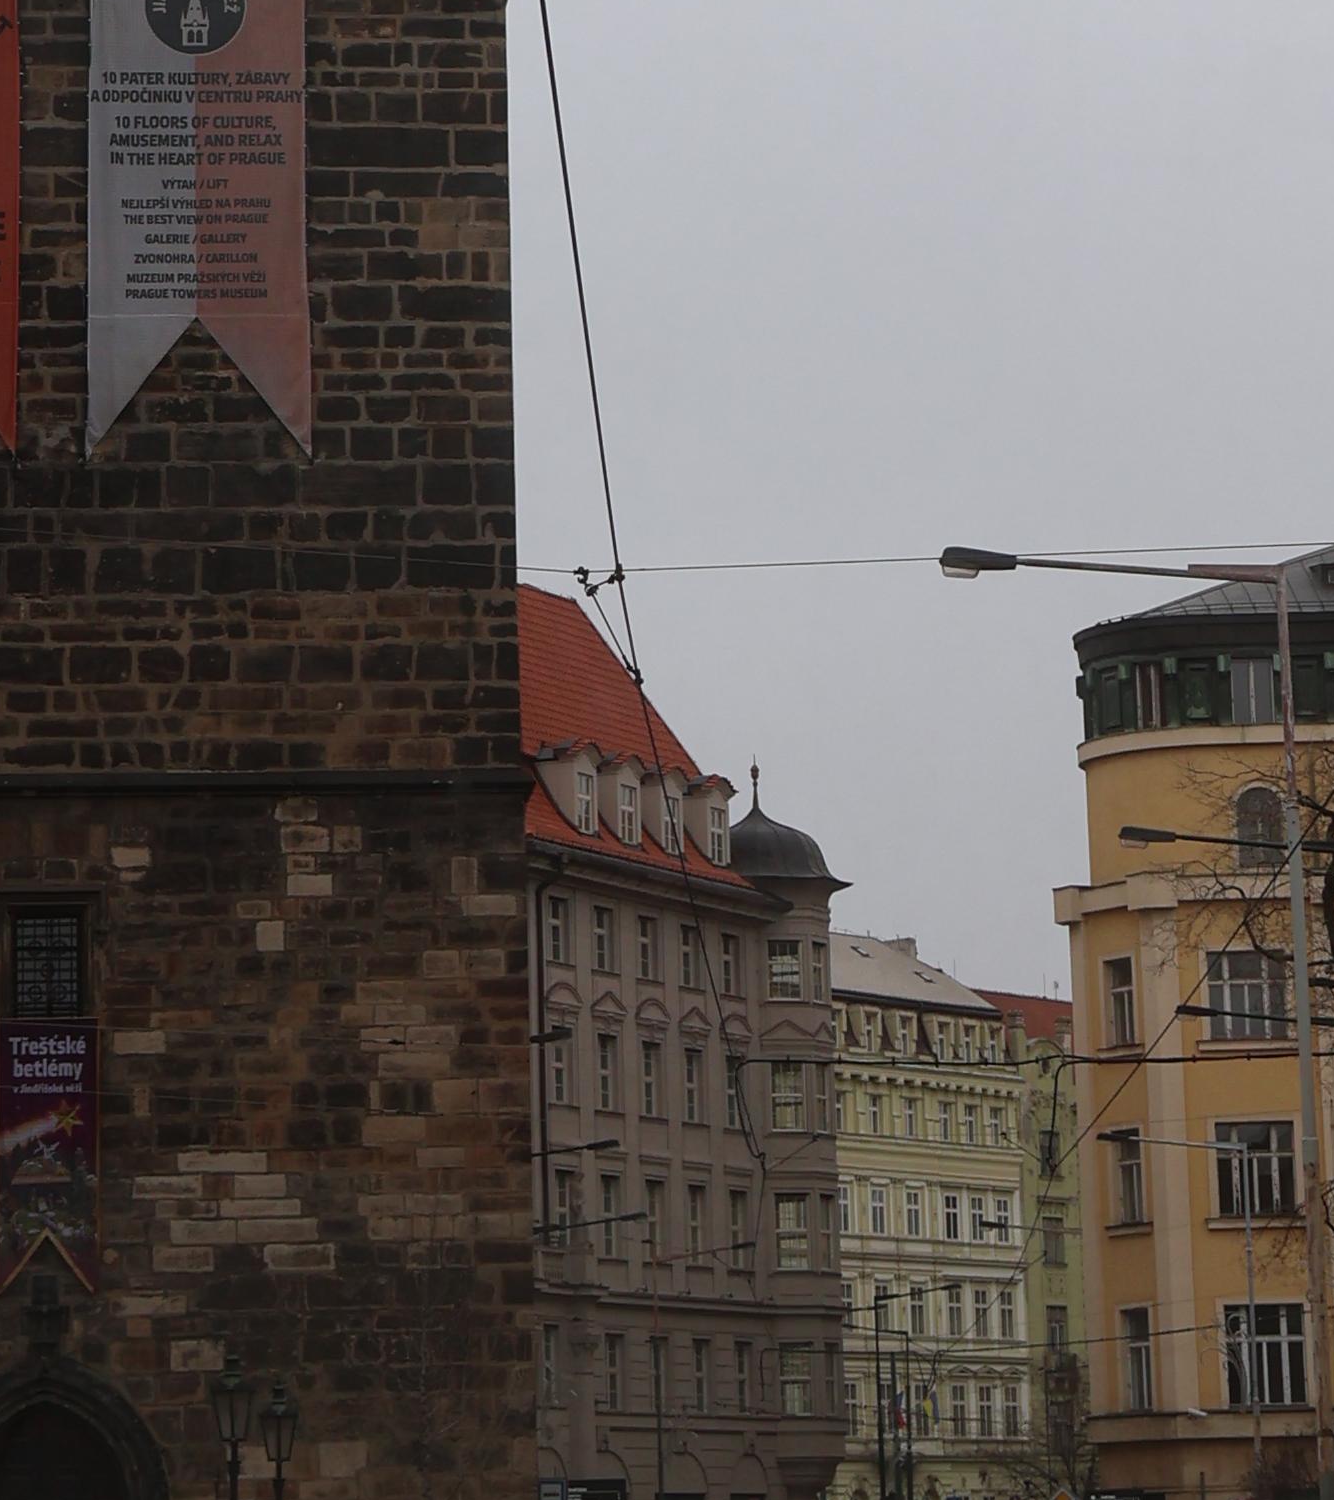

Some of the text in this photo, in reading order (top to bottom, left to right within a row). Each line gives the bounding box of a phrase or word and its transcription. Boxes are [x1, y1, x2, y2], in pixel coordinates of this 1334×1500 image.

[102, 70, 291, 88] 10 PATER KULTURY, ZÁBAVY
[90, 87, 303, 103] A ODPOČINKU V CENTRU PRAHY
[115, 116, 277, 131] 10 FLOORS OF CULTURE,
[109, 133, 283, 149] AMUSEMENT, AND RELAX
[110, 152, 286, 165] IN THE HEART OF PRAGUE
[161, 177, 196, 190] VÝTAH
[206, 179, 229, 190] LIFT
[121, 196, 271, 209] NEJLEPŠÍ VÝHLED NA PRAHU
[123, 213, 268, 225] THE BEST VIEW ON PRAGUE
[144, 233, 190, 244] GALERIE
[200, 233, 247, 244] GALLERY
[134, 253, 195, 264] ZVONOHRA
[205, 253, 258, 263] CARILLON
[126, 273, 174, 283] MUZEUM
[125, 288, 268, 299] PRAGUE TOWERS MUSEUM
[8, 1034, 87, 1055] Třešťské
[12, 1057, 84, 1081] betlémy
